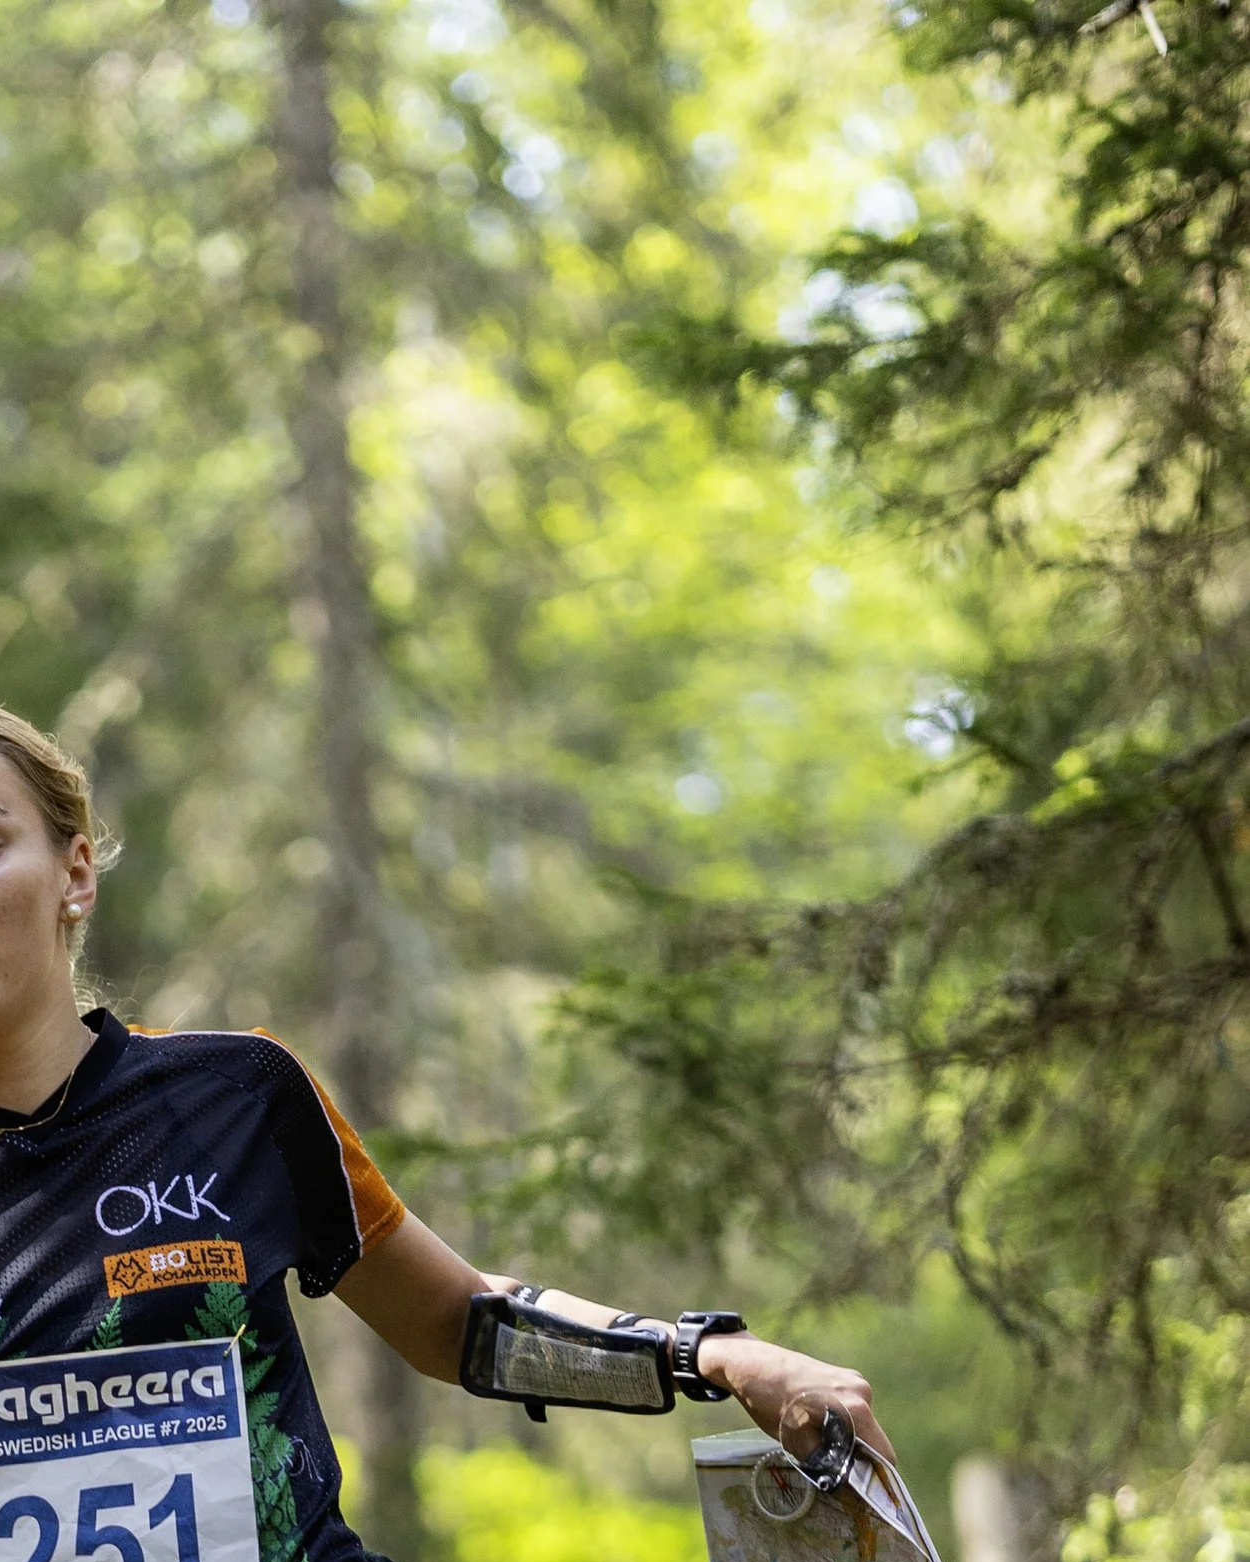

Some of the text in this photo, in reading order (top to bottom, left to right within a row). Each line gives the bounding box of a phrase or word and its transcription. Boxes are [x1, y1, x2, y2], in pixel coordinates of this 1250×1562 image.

[95, 1172, 231, 1236] OKK
[149, 1248, 236, 1272] BOLIST
[82, 1423, 155, 1447] LEAGUE
[160, 1419, 181, 1437] #7
[186, 1414, 228, 1434] 2025
